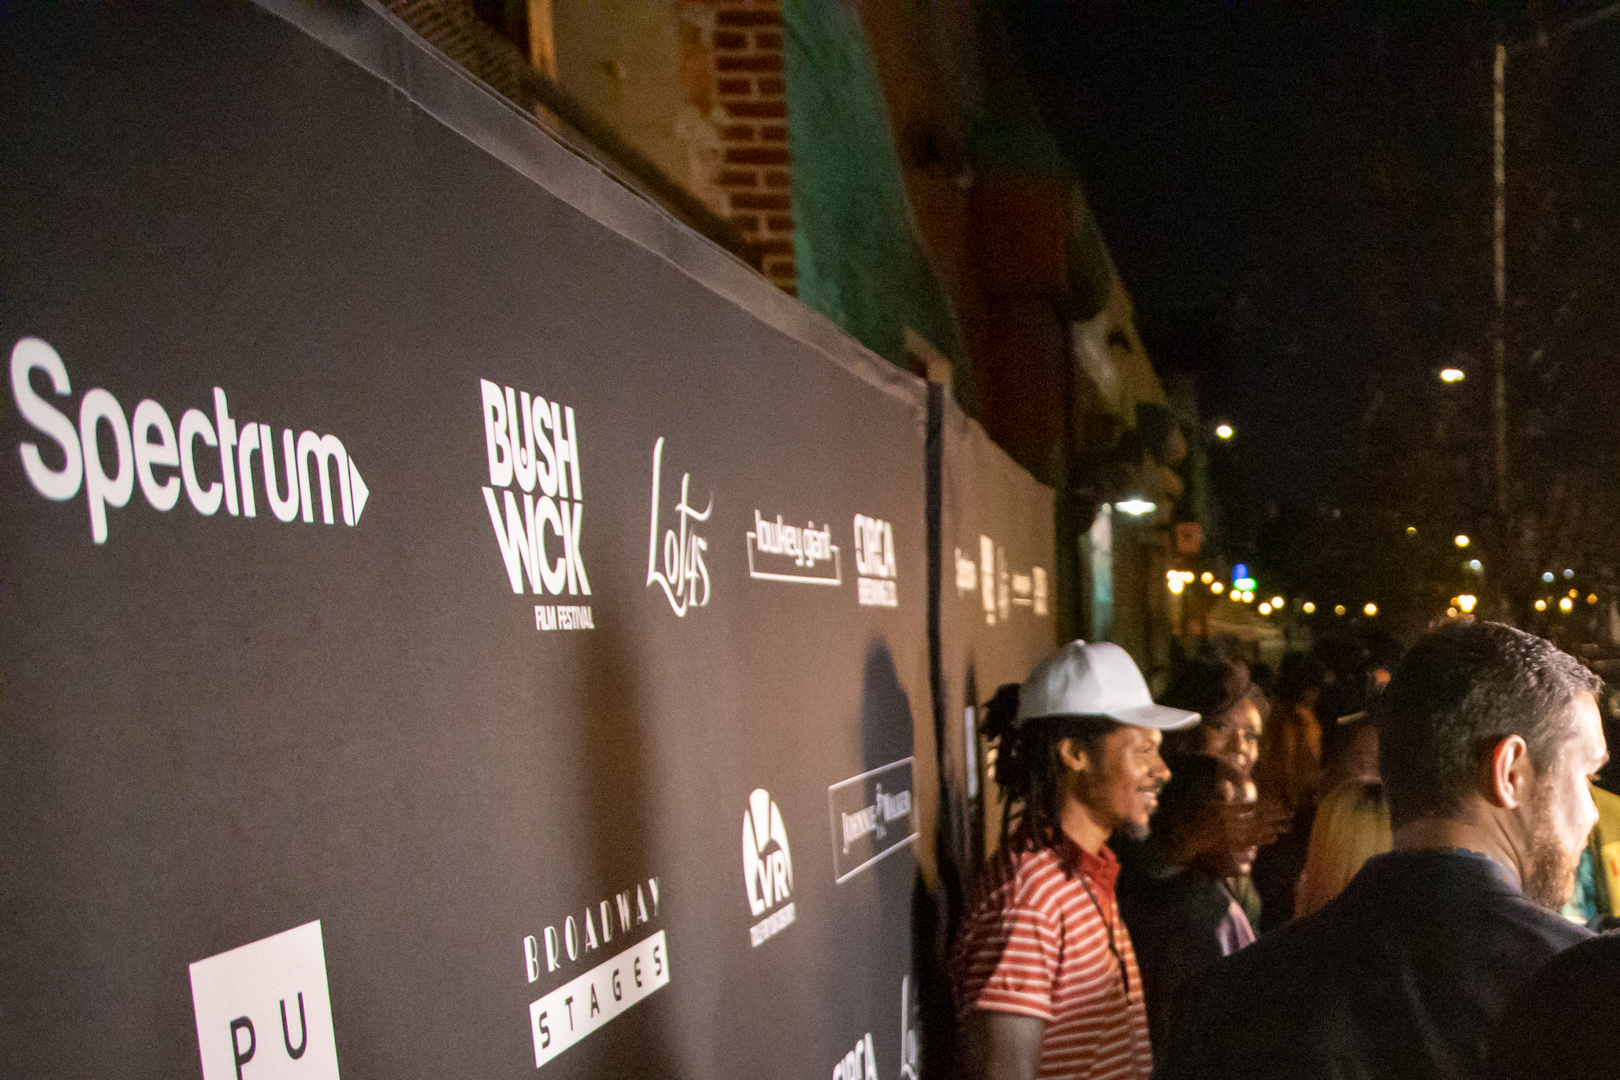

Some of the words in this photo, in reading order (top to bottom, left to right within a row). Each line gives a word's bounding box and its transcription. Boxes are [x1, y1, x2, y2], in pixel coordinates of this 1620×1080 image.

[10, 337, 358, 544] Spectrum
[480, 378, 583, 500] BUSH
[482, 486, 592, 596] WCK
[534, 605, 557, 630] FILM
[524, 876, 660, 983] BROADWAY
[538, 945, 662, 1050] STAGES
